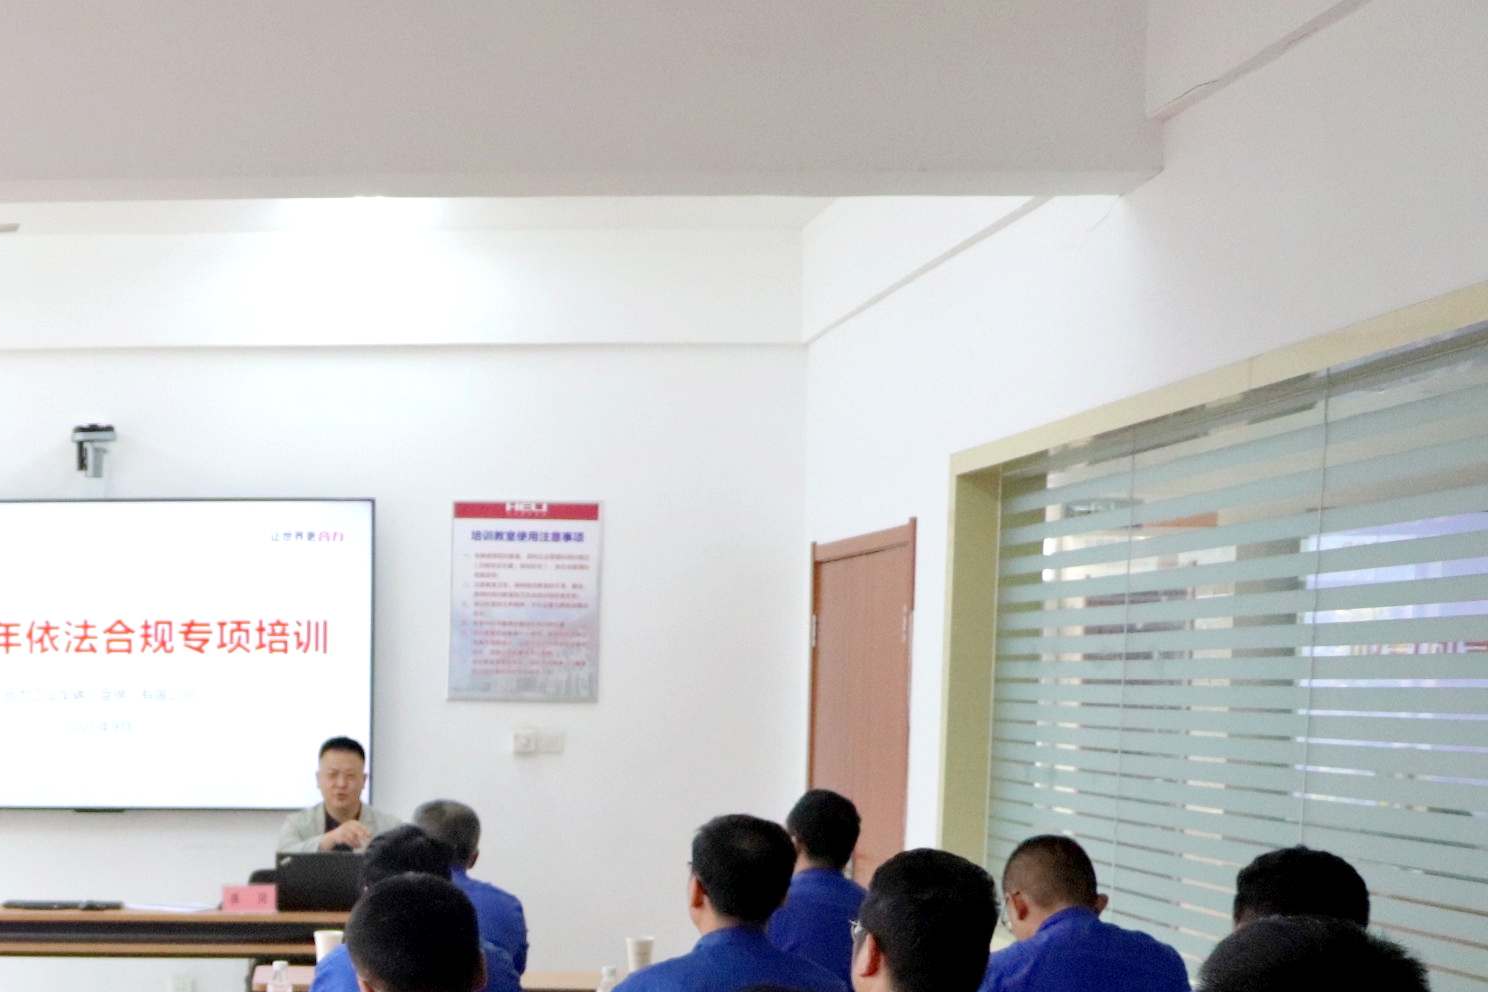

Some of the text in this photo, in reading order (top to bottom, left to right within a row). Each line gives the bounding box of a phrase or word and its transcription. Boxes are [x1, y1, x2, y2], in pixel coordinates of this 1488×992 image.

[270, 530, 345, 542] 让世界更合力
[471, 530, 585, 542] 培训教室使用注意事项
